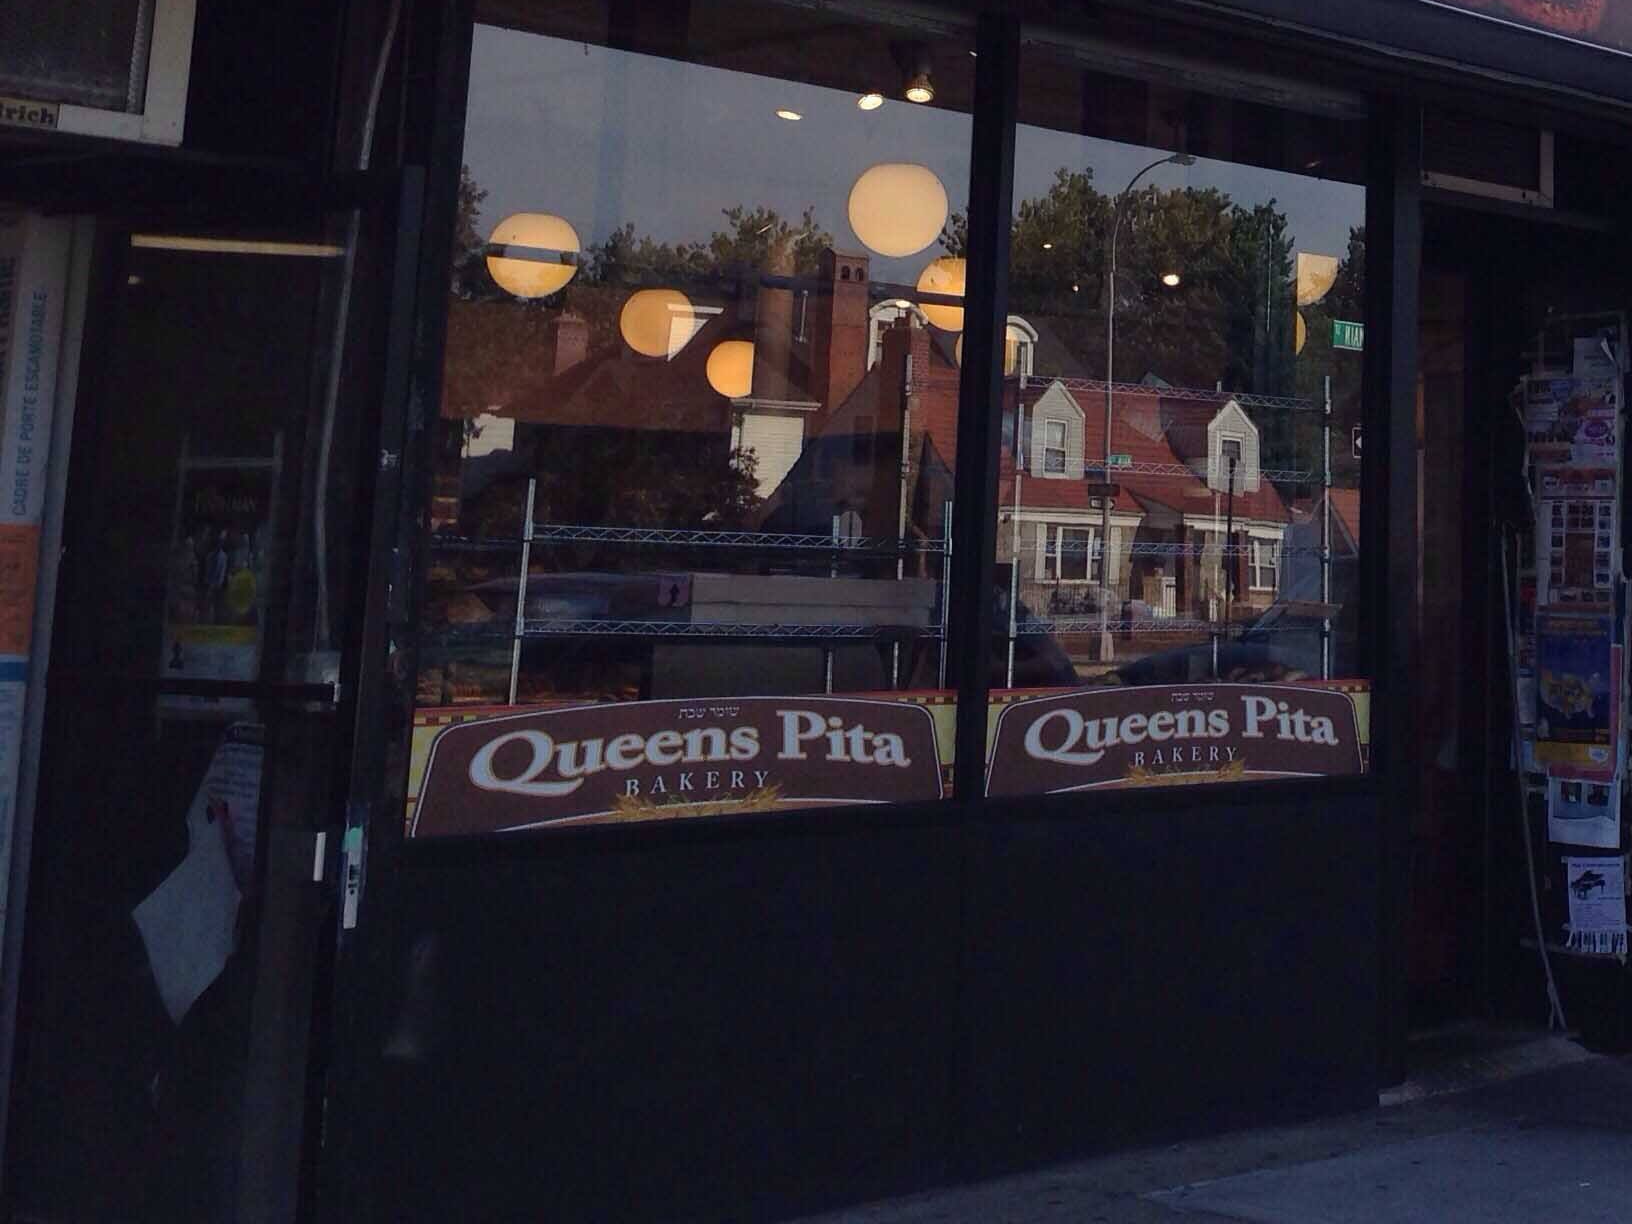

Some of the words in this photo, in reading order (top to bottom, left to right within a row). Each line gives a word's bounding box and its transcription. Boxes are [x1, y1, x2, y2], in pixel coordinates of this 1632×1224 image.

[0, 104, 53, 124] rich
[1024, 694, 1231, 766] Queens
[1240, 694, 1339, 748] Pita
[468, 711, 760, 796] Queens
[777, 711, 912, 768] Pita
[1133, 745, 1238, 767] BAKERY
[625, 769, 771, 799] BAKERY
